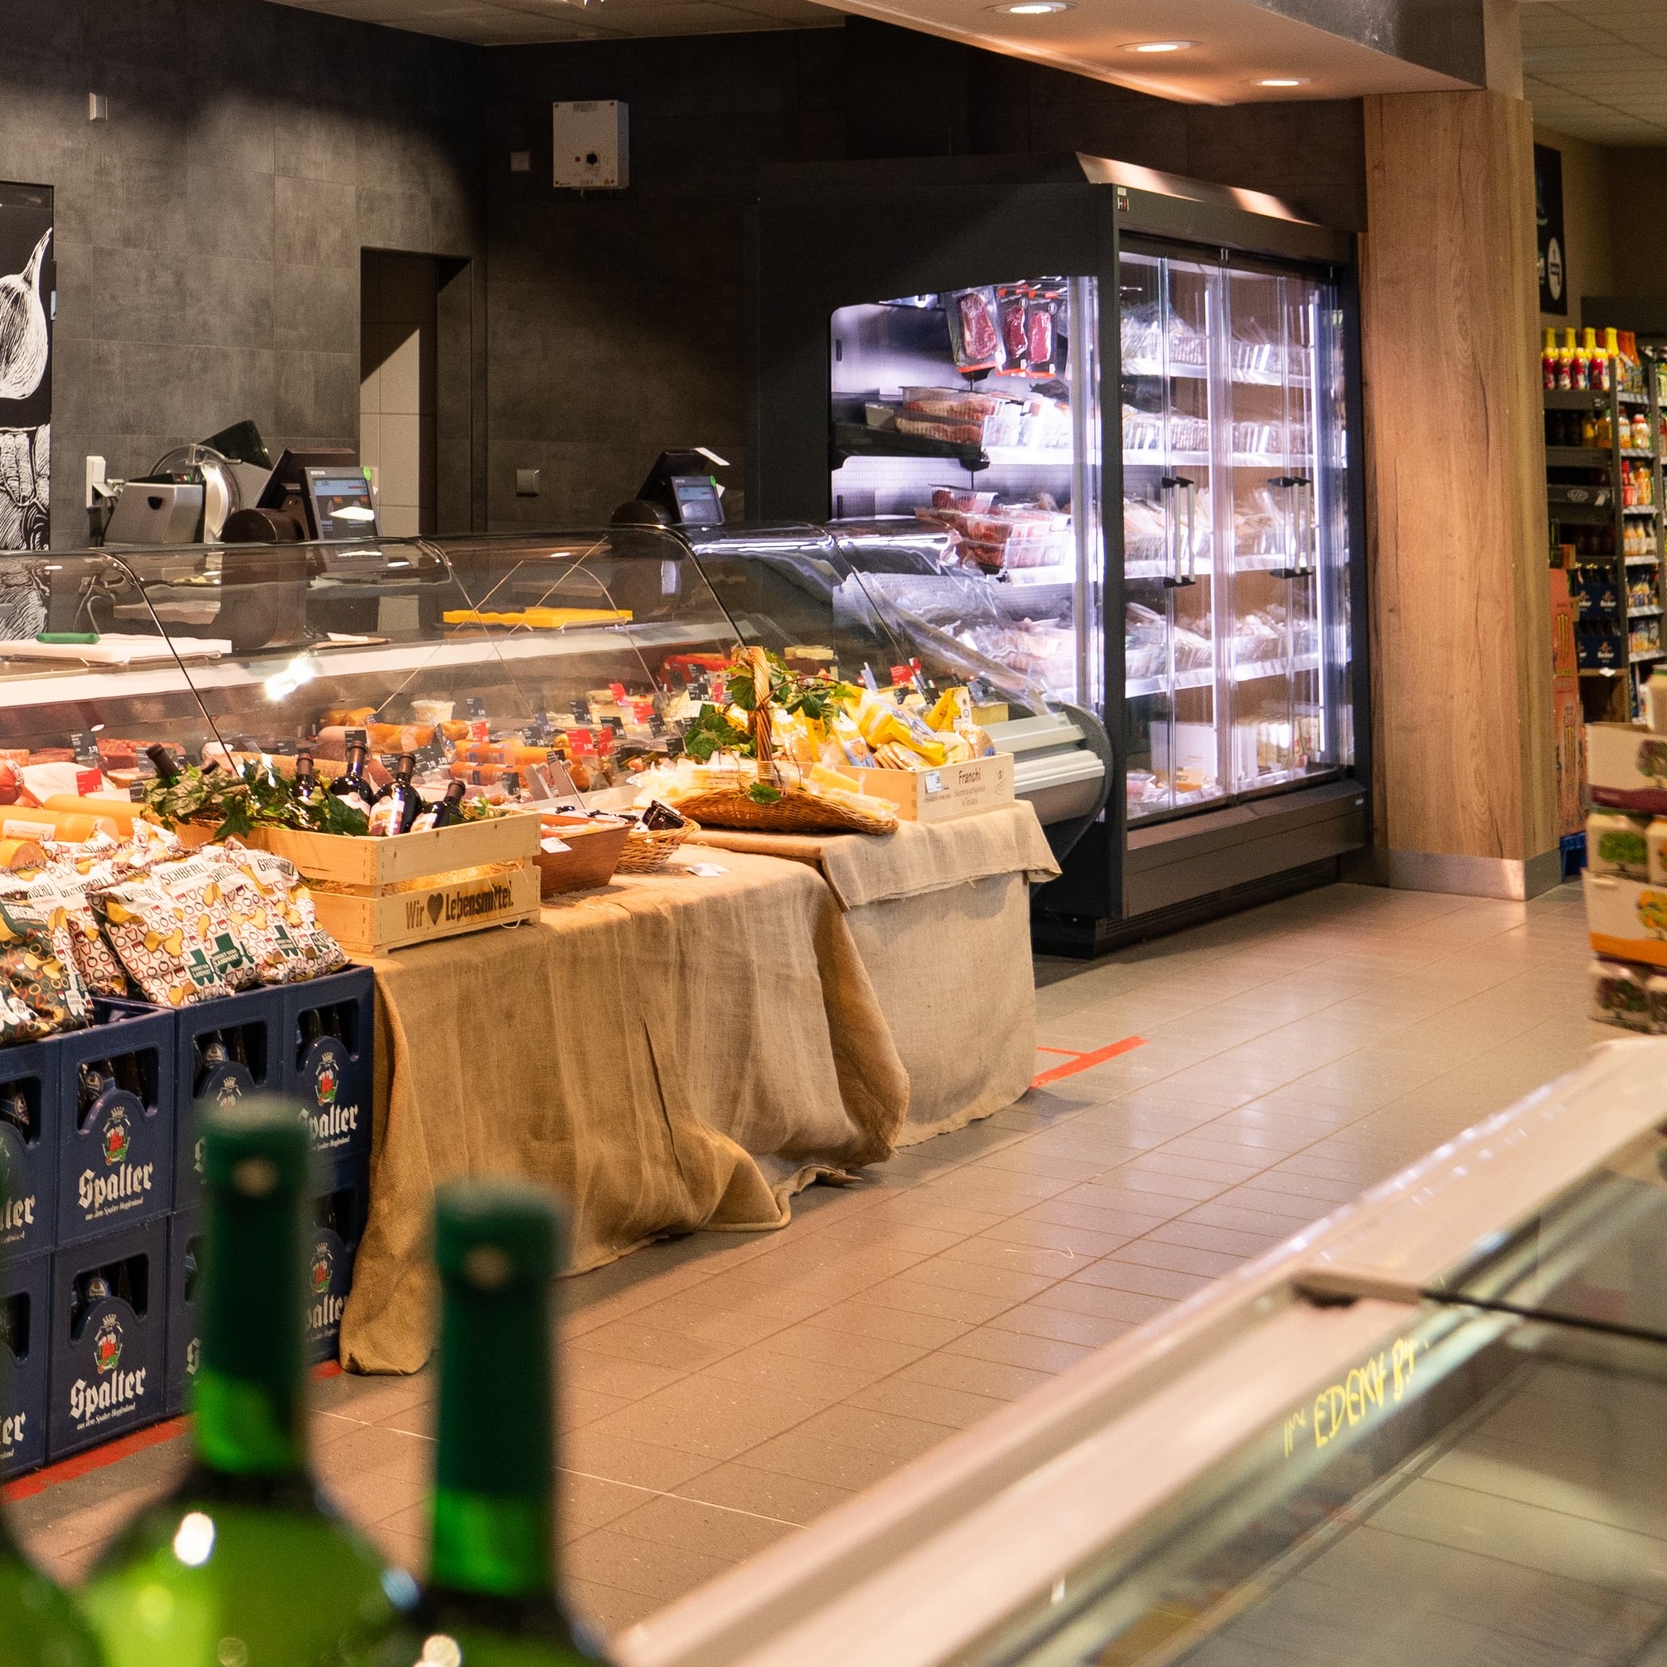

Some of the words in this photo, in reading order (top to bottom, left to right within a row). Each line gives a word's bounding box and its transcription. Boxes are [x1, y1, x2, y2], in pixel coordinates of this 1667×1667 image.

[405, 900, 425, 930] Wir
[445, 879, 514, 923] Lebensmittel.
[77, 1162, 153, 1213] Spalter
[69, 1366, 147, 1423] Spalter
